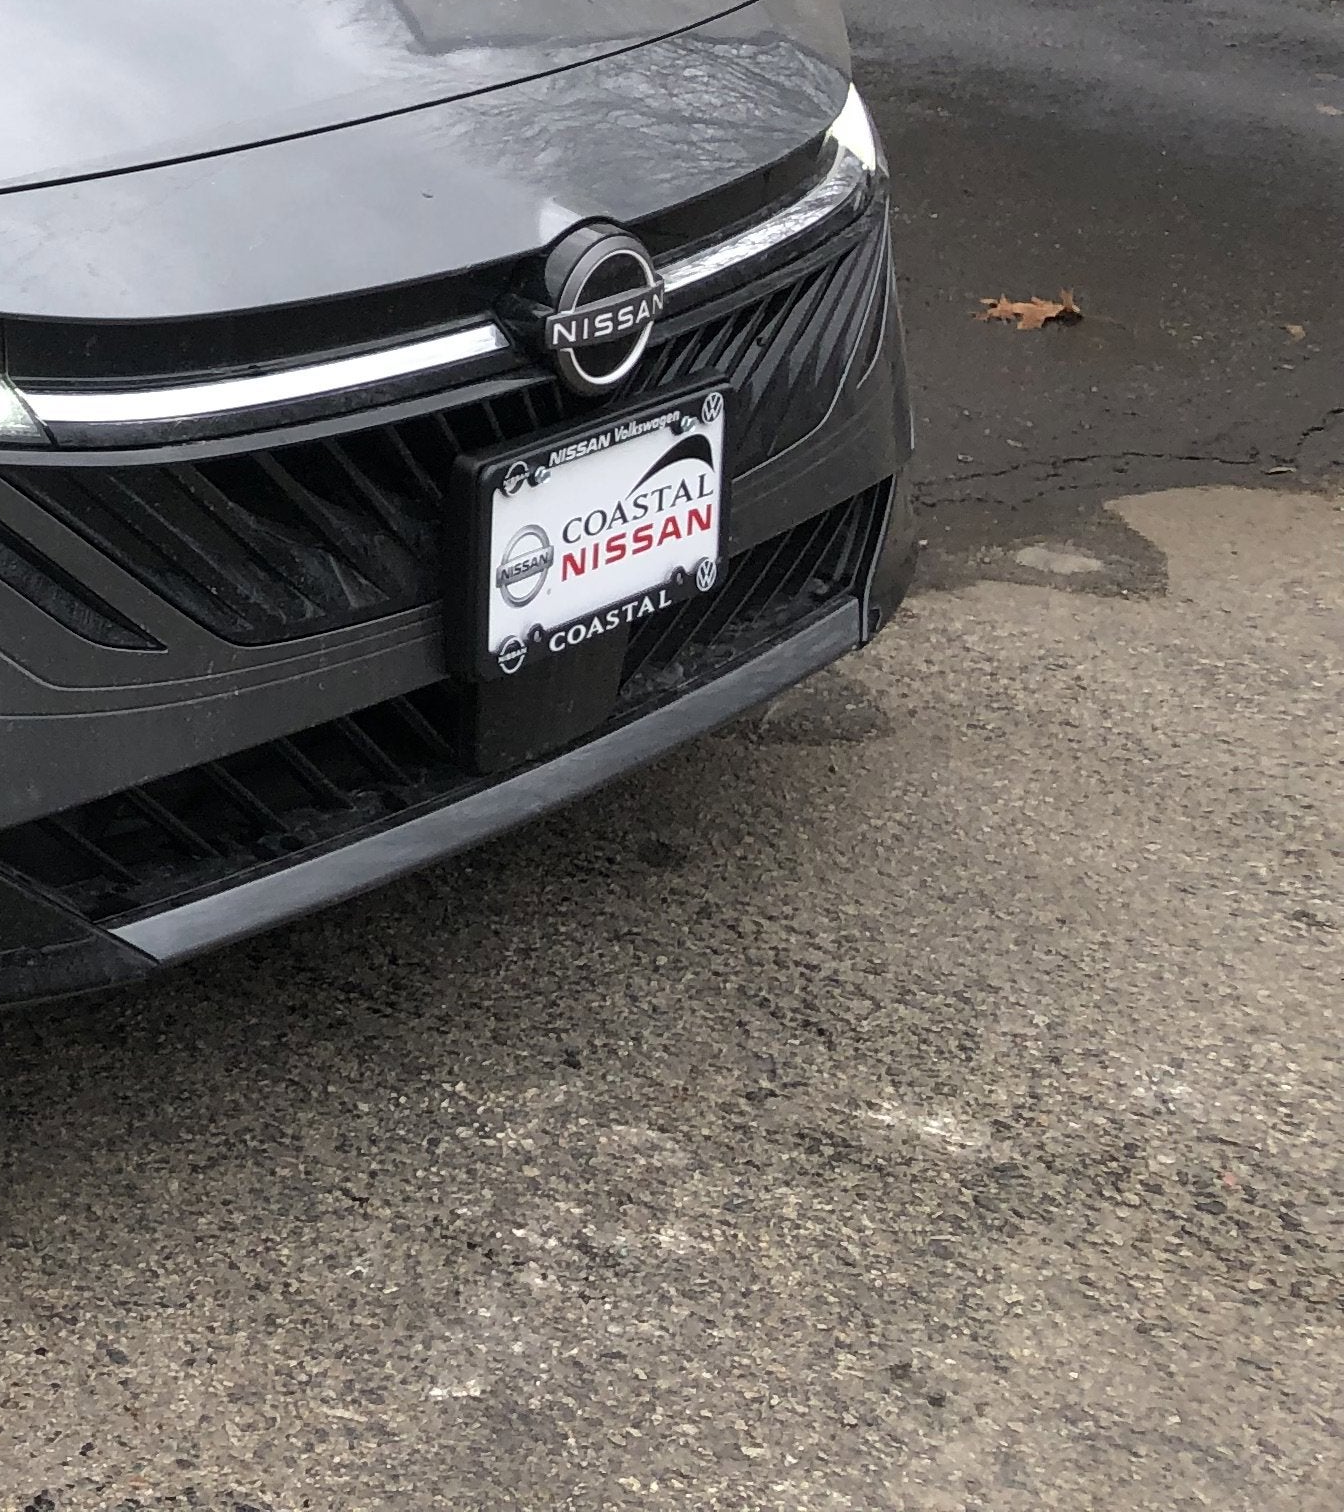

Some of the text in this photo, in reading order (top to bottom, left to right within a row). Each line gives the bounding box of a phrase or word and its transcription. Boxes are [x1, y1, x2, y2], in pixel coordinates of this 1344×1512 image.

[552, 287, 664, 345] NISSAN
[549, 410, 681, 466] NISSAN Volkswagen
[563, 473, 714, 544] COASTAL
[500, 551, 549, 581] NISSAN
[561, 504, 712, 582] NISSAN
[549, 589, 673, 652] COASTAL
